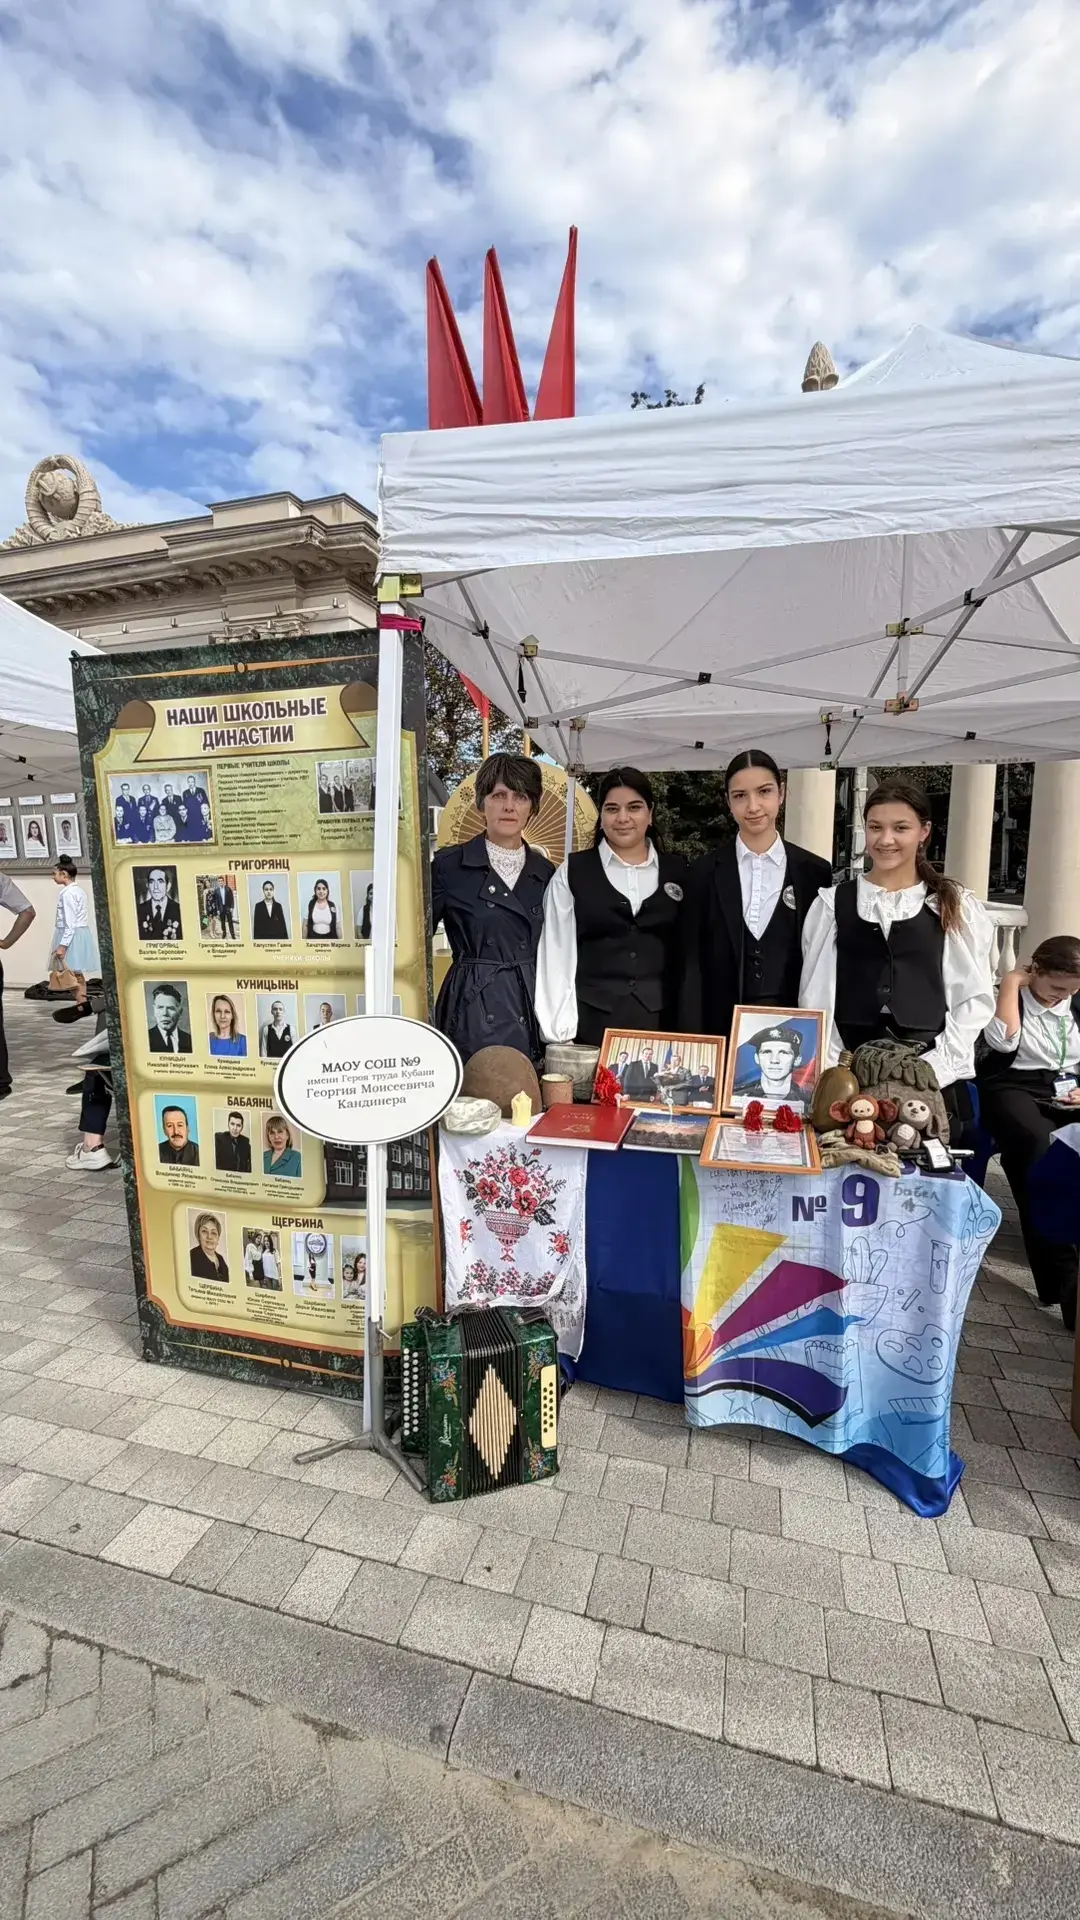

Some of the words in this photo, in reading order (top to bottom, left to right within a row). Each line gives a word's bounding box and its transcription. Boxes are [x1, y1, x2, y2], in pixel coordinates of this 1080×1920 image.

[167, 706, 218, 726] НАШИ
[223, 697, 327, 722] ШКОЛЬНЫЕ
[202, 725, 294, 751] ДИНАСТИИ
[216, 762, 240, 770] ПЕРВЫЕ
[241, 761, 266, 769] УЧИТЕЛЯ
[228, 859, 290, 871] ГРИГОРЯНЦ
[236, 979, 298, 991] КУНИЦЫНЫ
[321, 1060, 361, 1074] МАОУ
[364, 1058, 397, 1070] СОШ
[400, 1056, 421, 1067] №9
[307, 1077, 339, 1086] имени
[341, 1074, 369, 1084] Героя
[371, 1072, 398, 1082] труда
[401, 1069, 435, 1079] Кубани
[306, 1087, 357, 1099] Георгия
[361, 1080, 435, 1094] Моисеевича
[227, 1096, 273, 1110] БАБАЯНЦ
[338, 1096, 407, 1109] Кандинера
[792, 1195, 827, 1222] №
[842, 1173, 881, 1227] 9
[272, 1216, 323, 1229] ЩЕРБИНА
